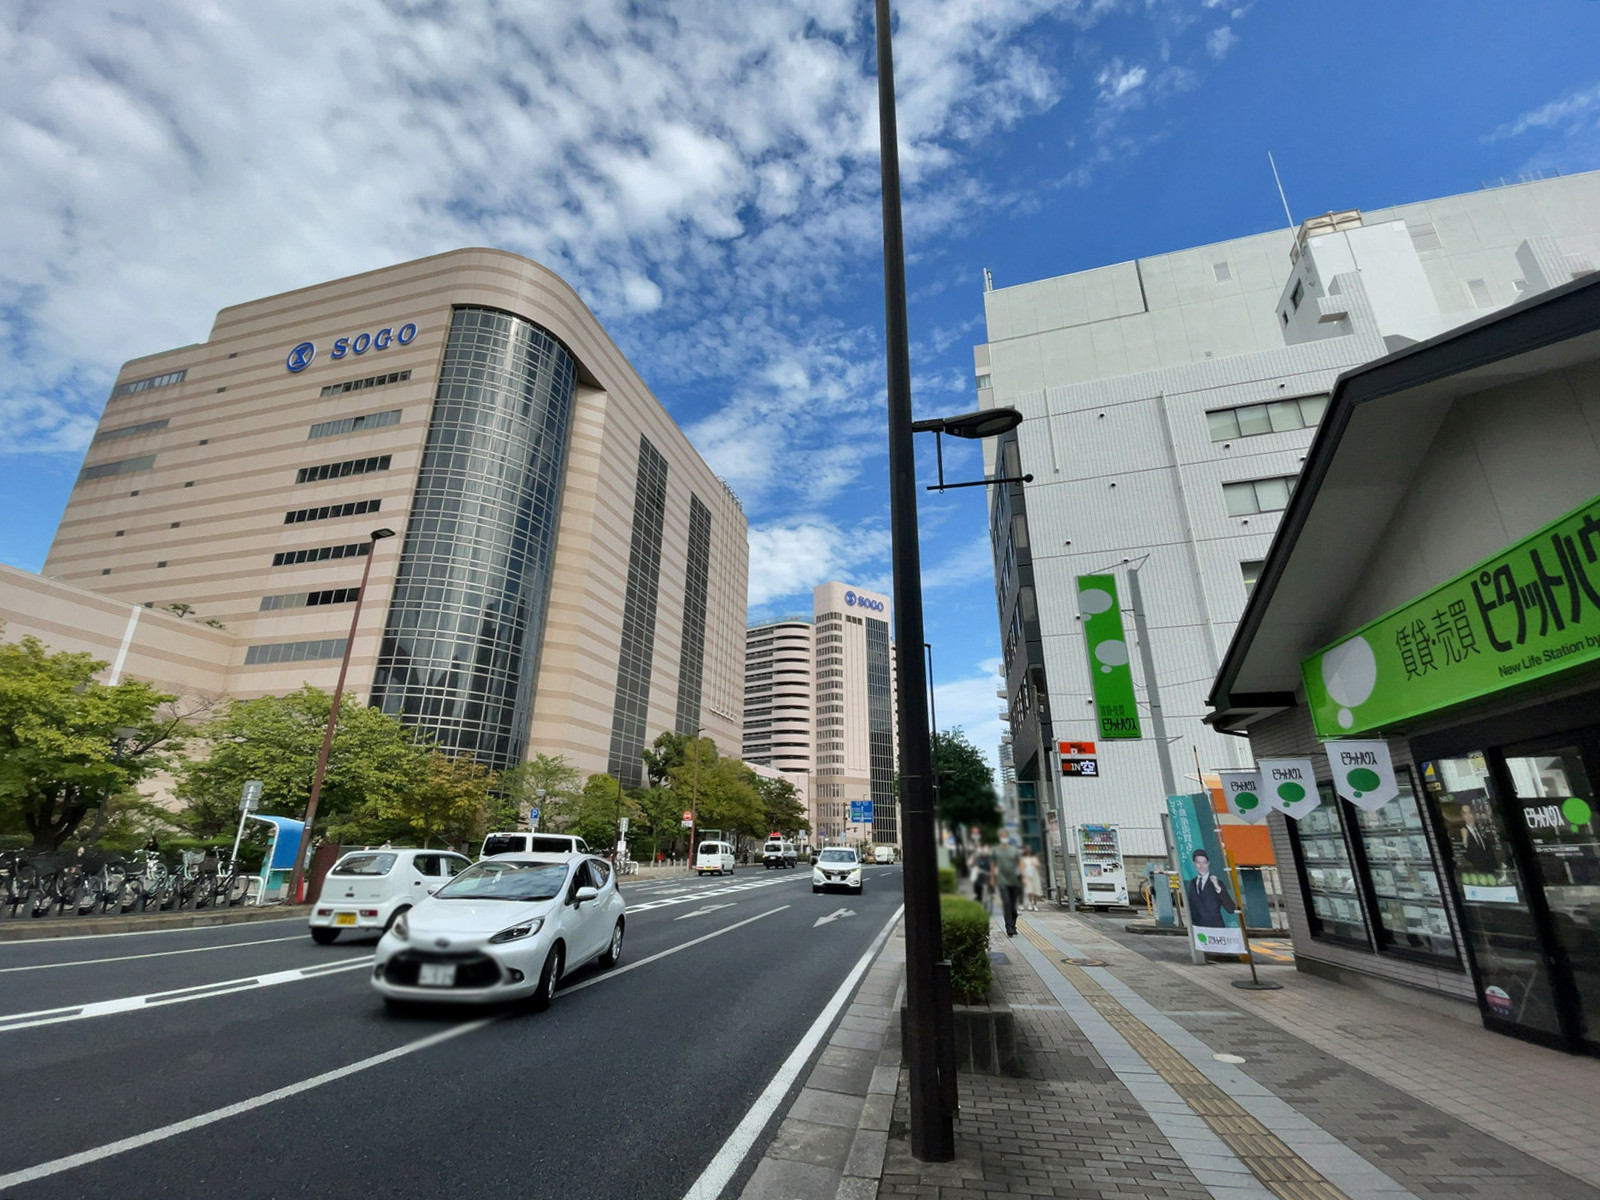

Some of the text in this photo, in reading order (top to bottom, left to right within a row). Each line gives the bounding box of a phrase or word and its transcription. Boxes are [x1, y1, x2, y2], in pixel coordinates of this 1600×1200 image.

[331, 323, 418, 359] SOGO
[857, 596, 884, 612] SOGO
[1498, 663, 1521, 678] New
[1521, 655, 1543, 670] Life
[1542, 642, 1585, 663] Station
[1340, 751, 1378, 765] ピタットハウス
[1080, 760, 1097, 775] 空
[1271, 768, 1303, 780] ピタットハウス
